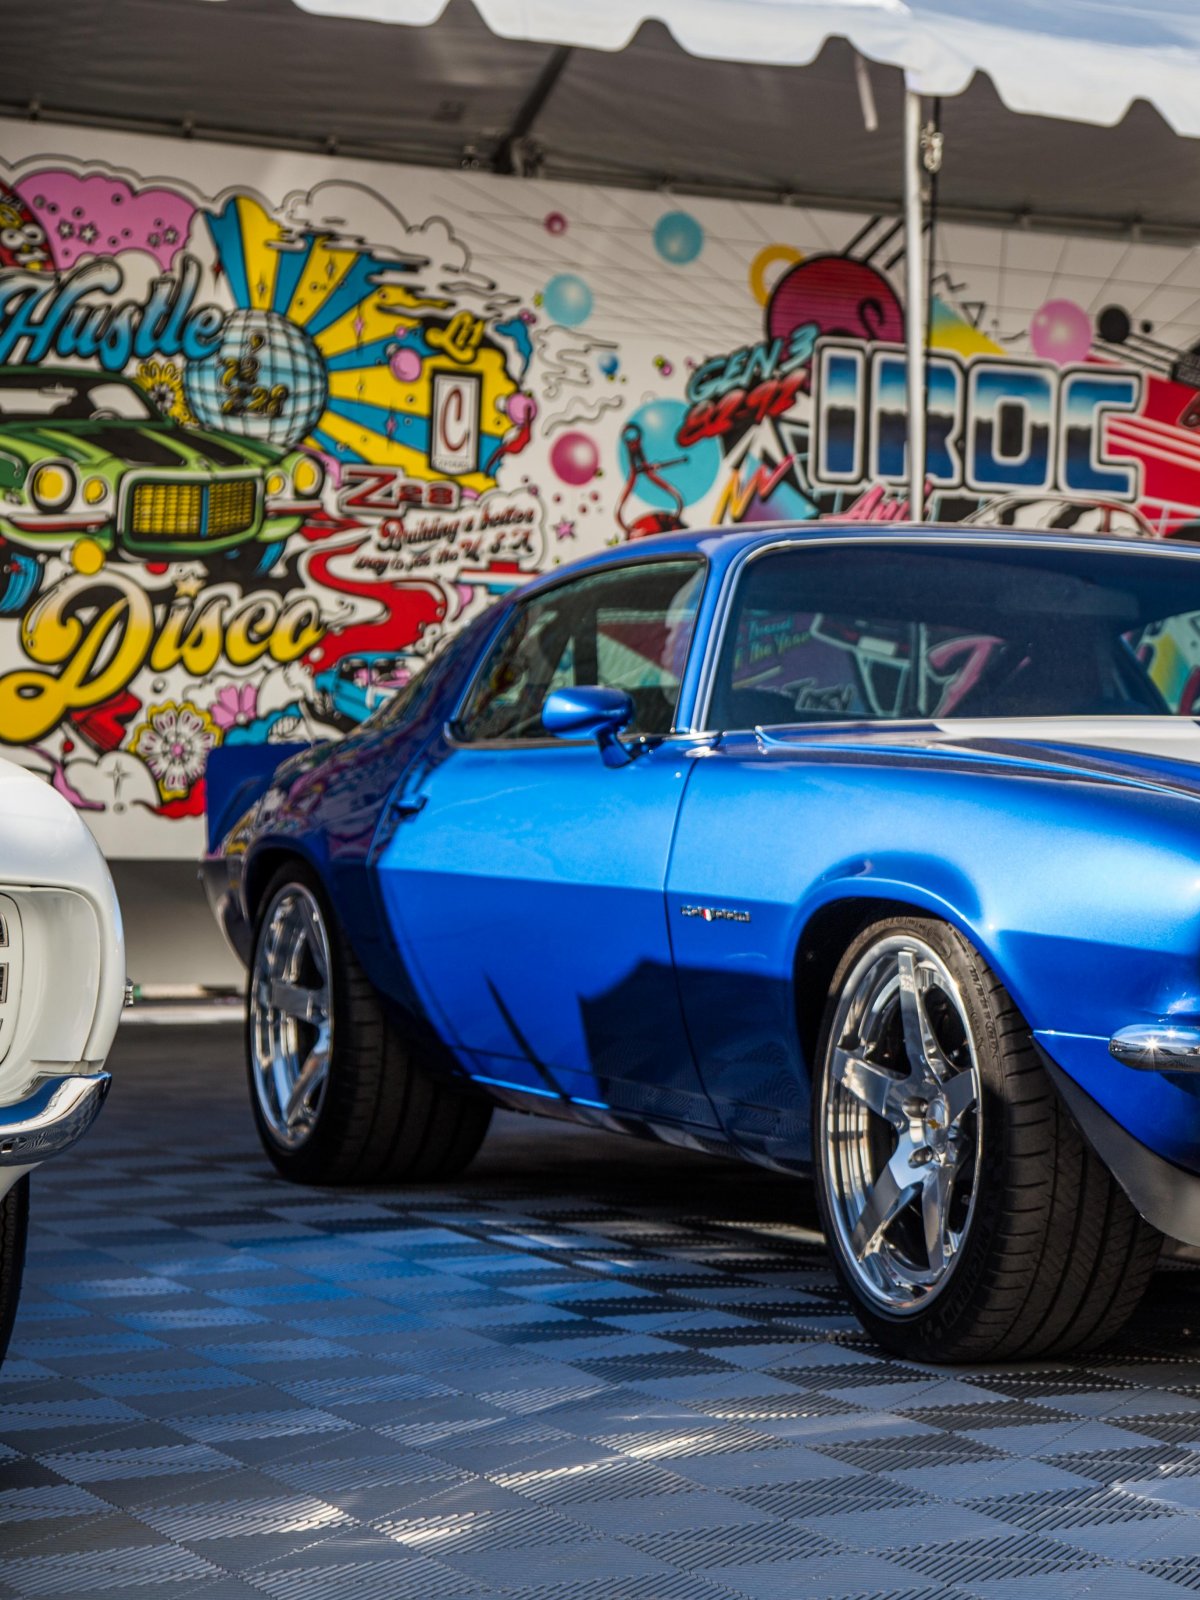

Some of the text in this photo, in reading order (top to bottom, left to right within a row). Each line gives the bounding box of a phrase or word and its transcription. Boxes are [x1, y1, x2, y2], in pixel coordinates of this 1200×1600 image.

[0, 256, 226, 371] Hustle
[686, 322, 820, 402] GEN 3
[810, 337, 1143, 500] IROC
[0, 570, 328, 744] Disco
